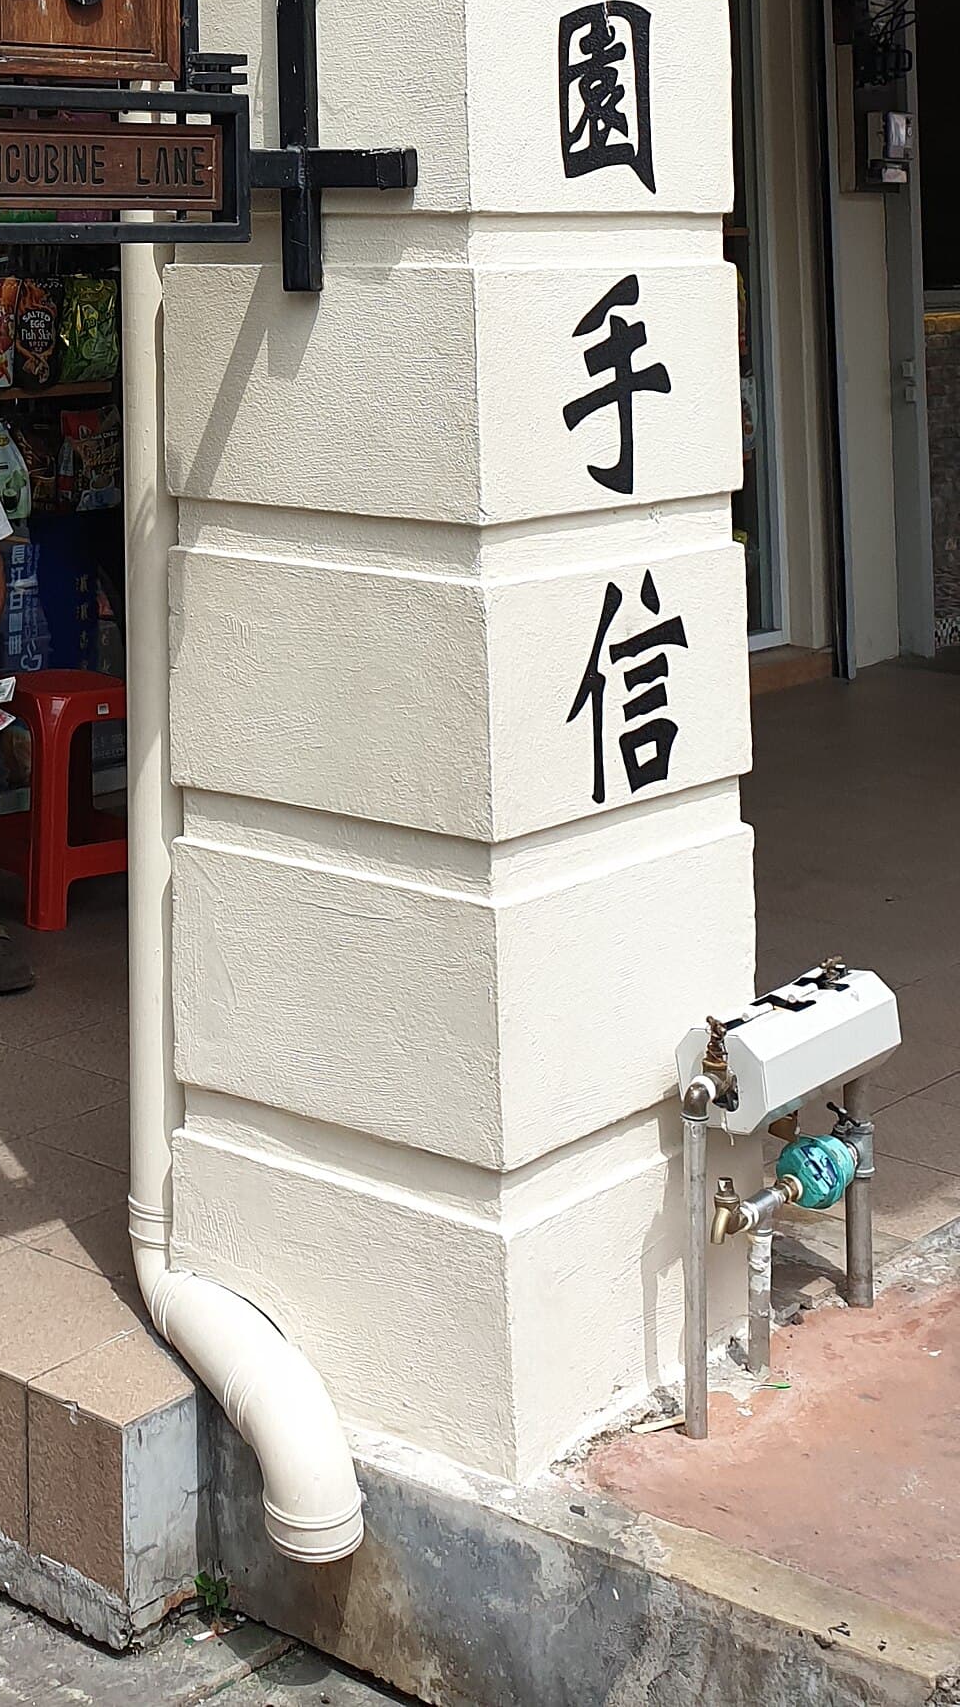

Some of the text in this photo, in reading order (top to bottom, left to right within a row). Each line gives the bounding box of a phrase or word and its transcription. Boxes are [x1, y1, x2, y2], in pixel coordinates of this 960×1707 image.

[135, 145, 207, 186] LANE
[22, 310, 51, 323] SALTED
[30, 319, 46, 329] EGG
